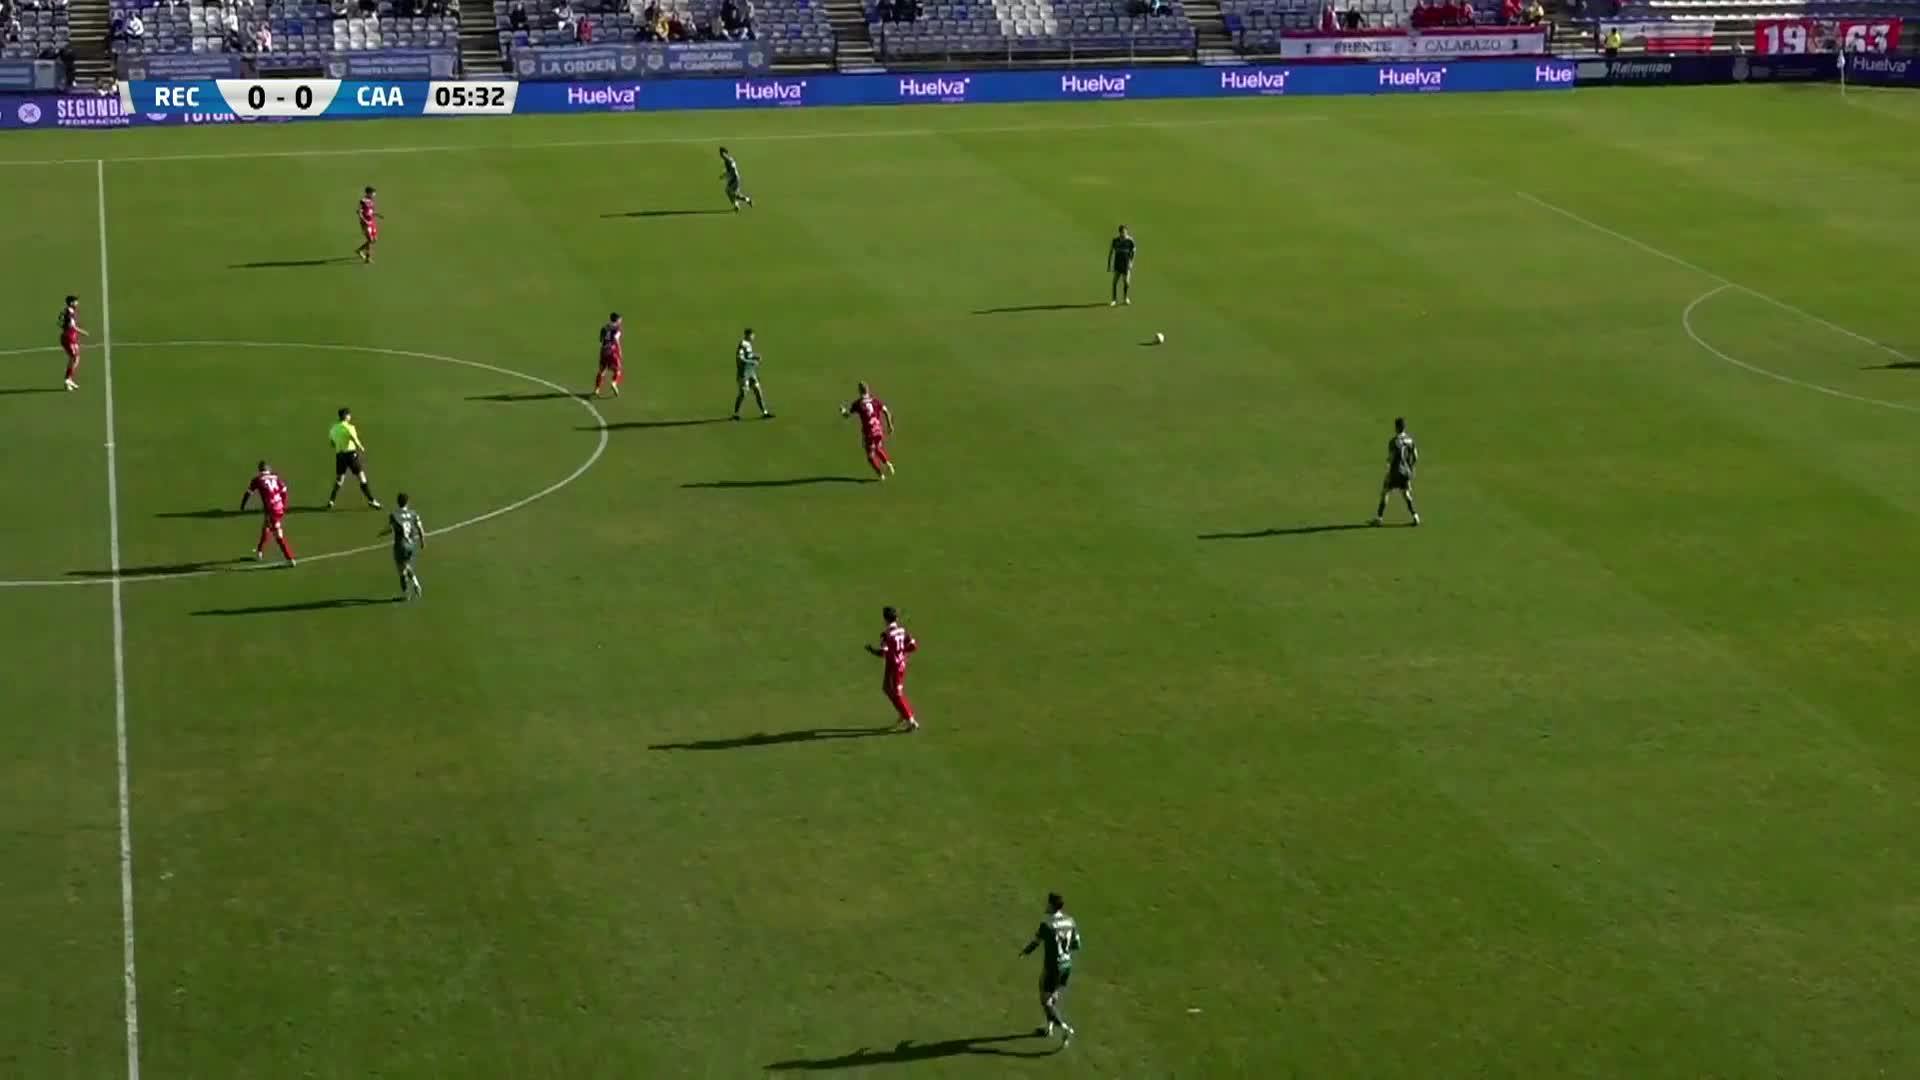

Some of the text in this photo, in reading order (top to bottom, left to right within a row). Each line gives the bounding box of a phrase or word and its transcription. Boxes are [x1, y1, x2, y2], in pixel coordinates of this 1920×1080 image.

[1764, 23, 1890, 55] 19 63
[541, 58, 617, 74] LA ORDEN
[1853, 55, 1908, 73] Huelva
[1062, 74, 1126, 92] Huelva
[1221, 71, 1285, 89] Huelva
[1379, 67, 1442, 86] Huelva
[568, 86, 636, 105] Huelva
[736, 81, 802, 100] Huelva
[900, 78, 965, 96] Huelva
